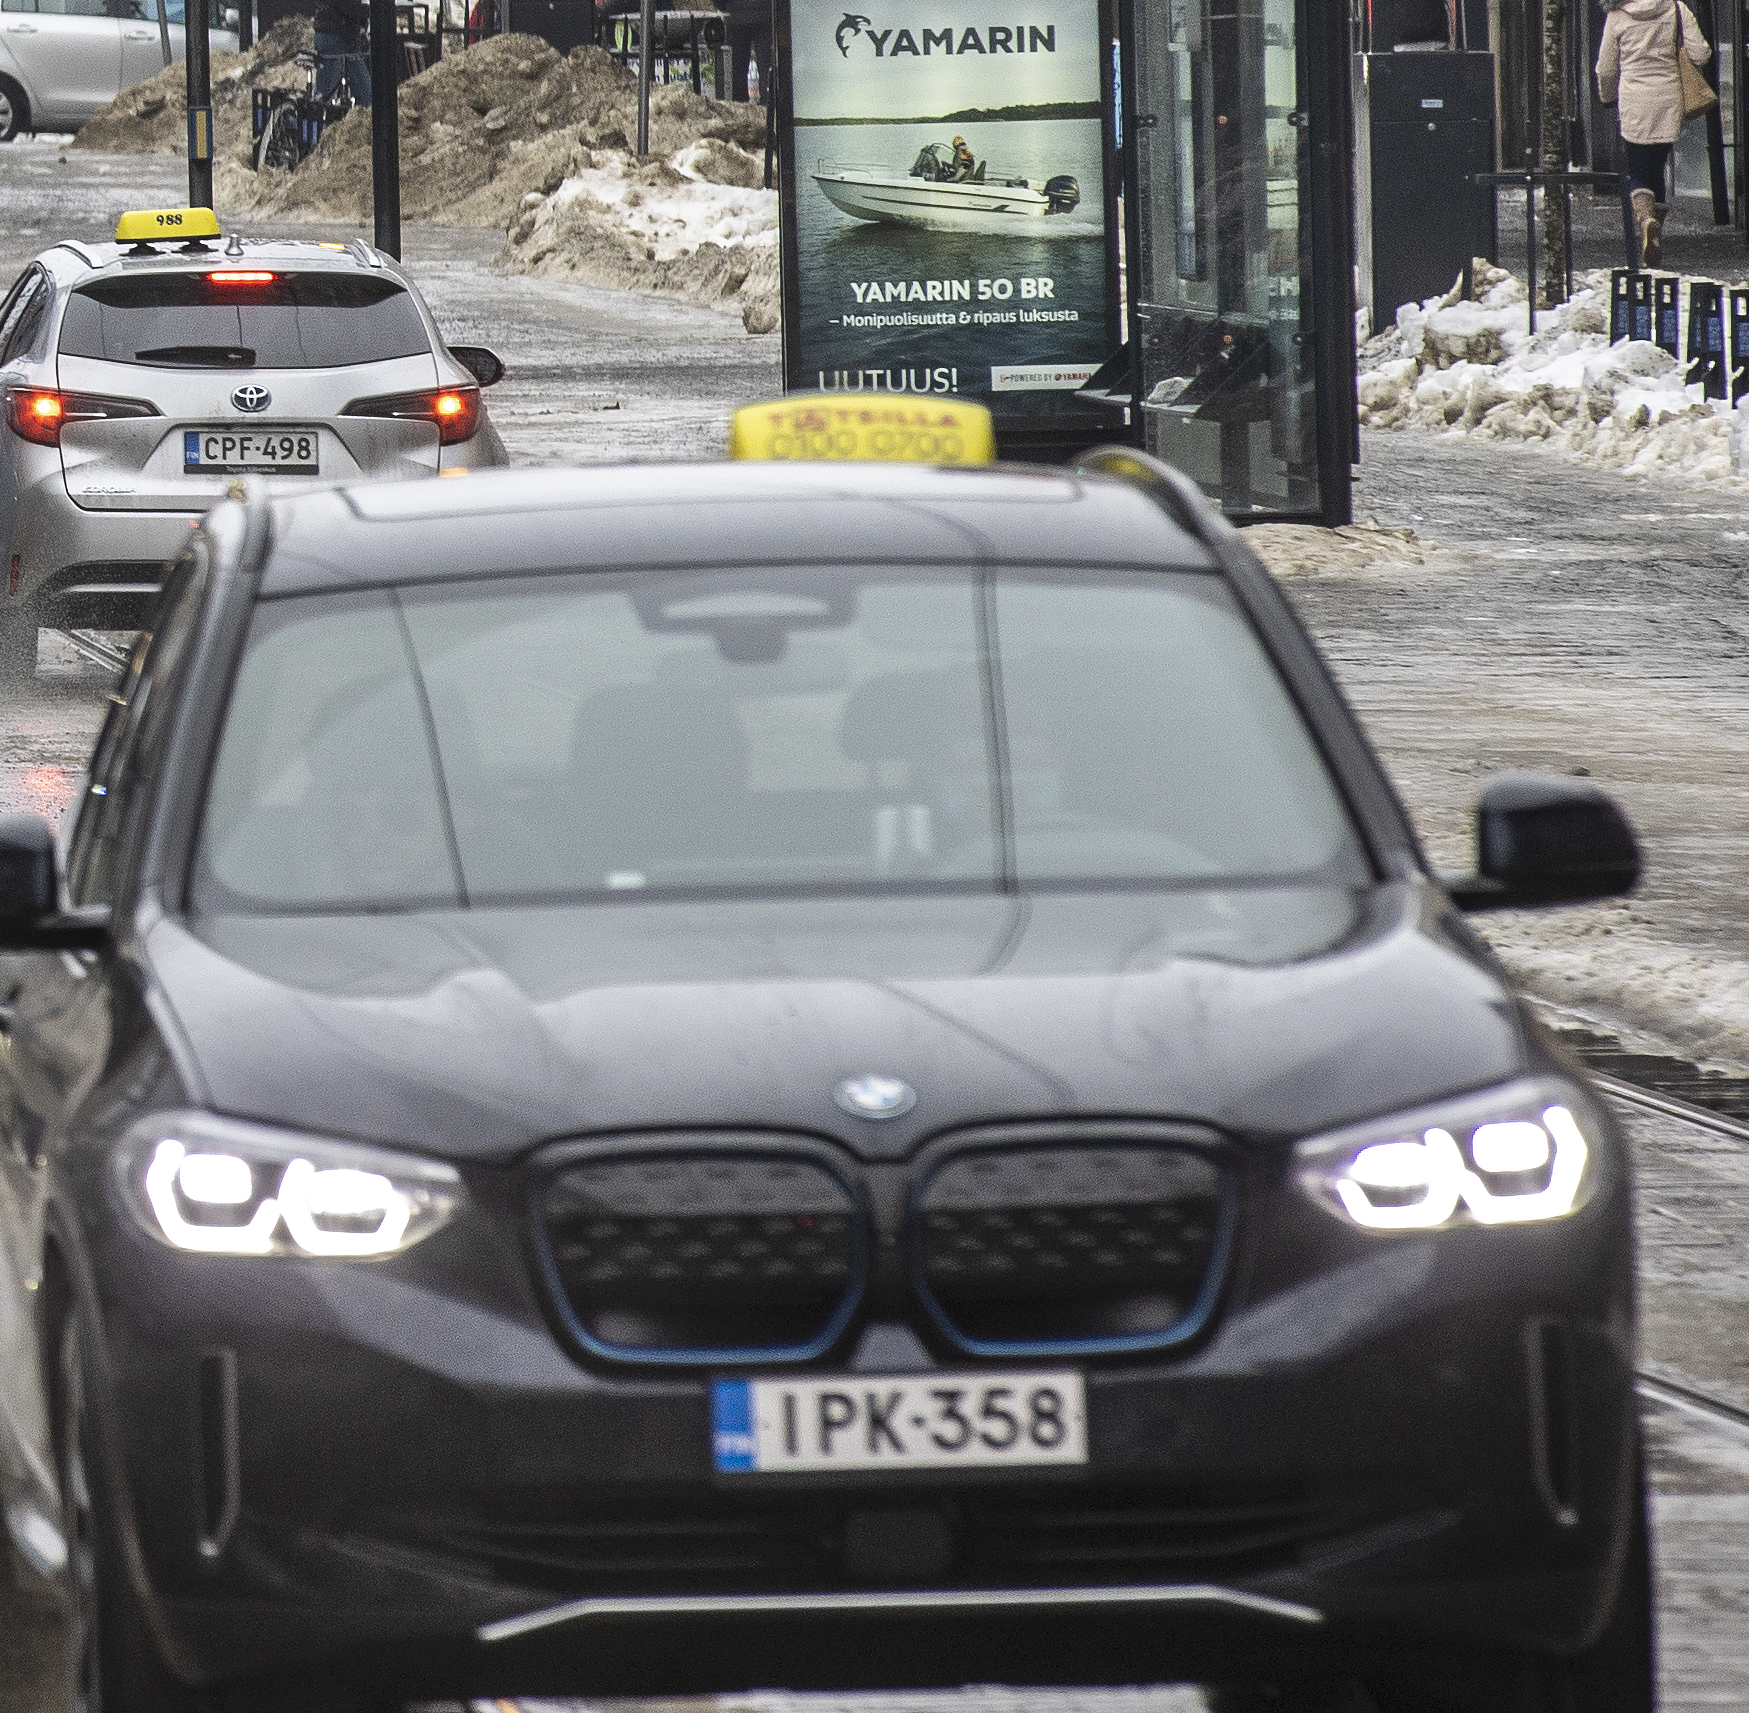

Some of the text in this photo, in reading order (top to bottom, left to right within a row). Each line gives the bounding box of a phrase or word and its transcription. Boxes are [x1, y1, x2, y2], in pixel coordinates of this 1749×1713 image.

[865, 25, 1056, 58] YAMARIN
[156, 214, 183, 225] 988
[851, 279, 971, 303] YAMARIN
[1020, 277, 1055, 300] BR
[843, 310, 956, 329] Monipuolisuutta
[958, 311, 971, 324] &
[974, 310, 1017, 327] ripaus
[1019, 308, 1079, 323] luksusta
[818, 367, 958, 393] UUTUUS!
